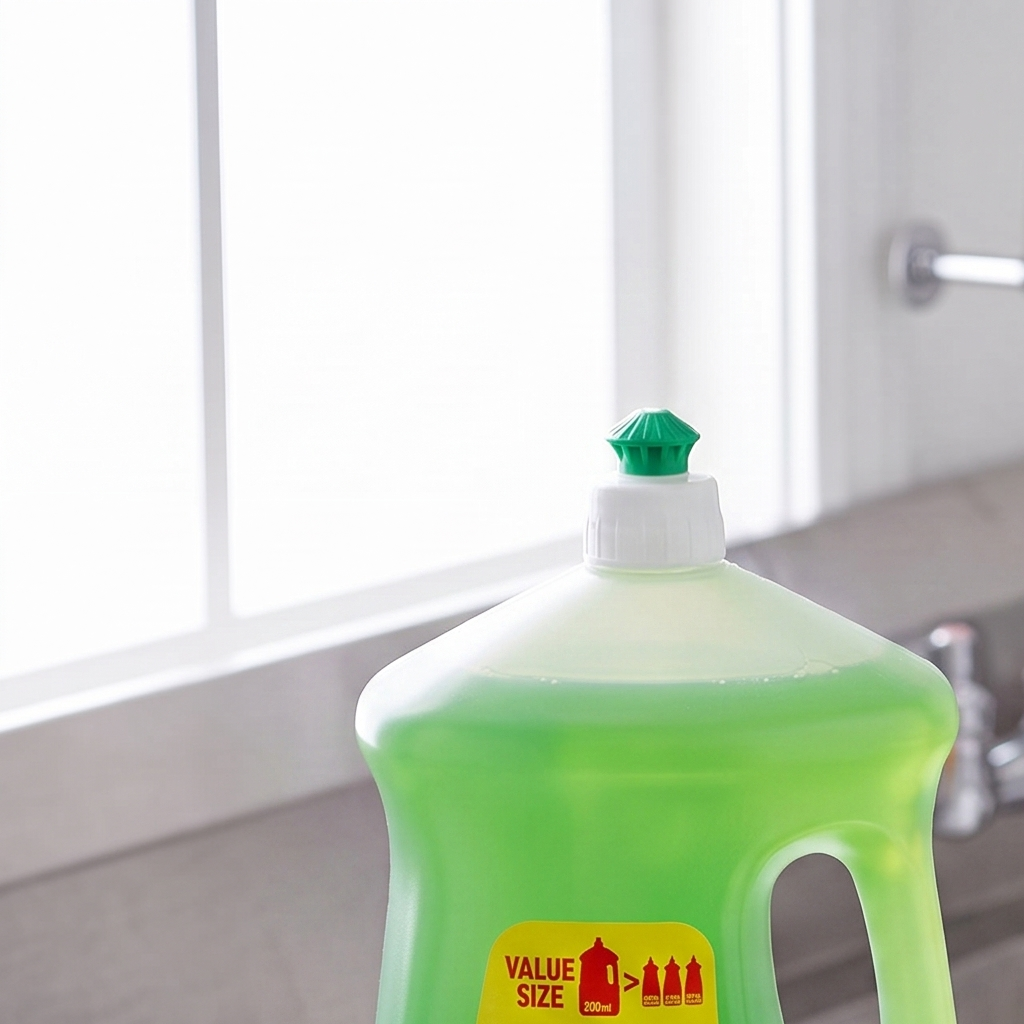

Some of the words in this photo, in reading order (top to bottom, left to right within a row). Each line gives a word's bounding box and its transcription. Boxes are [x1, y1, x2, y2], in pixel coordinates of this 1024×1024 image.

[505, 955, 575, 981] VALUE
[517, 983, 564, 1008] SIZE
[584, 1001, 612, 1012] 200ml
